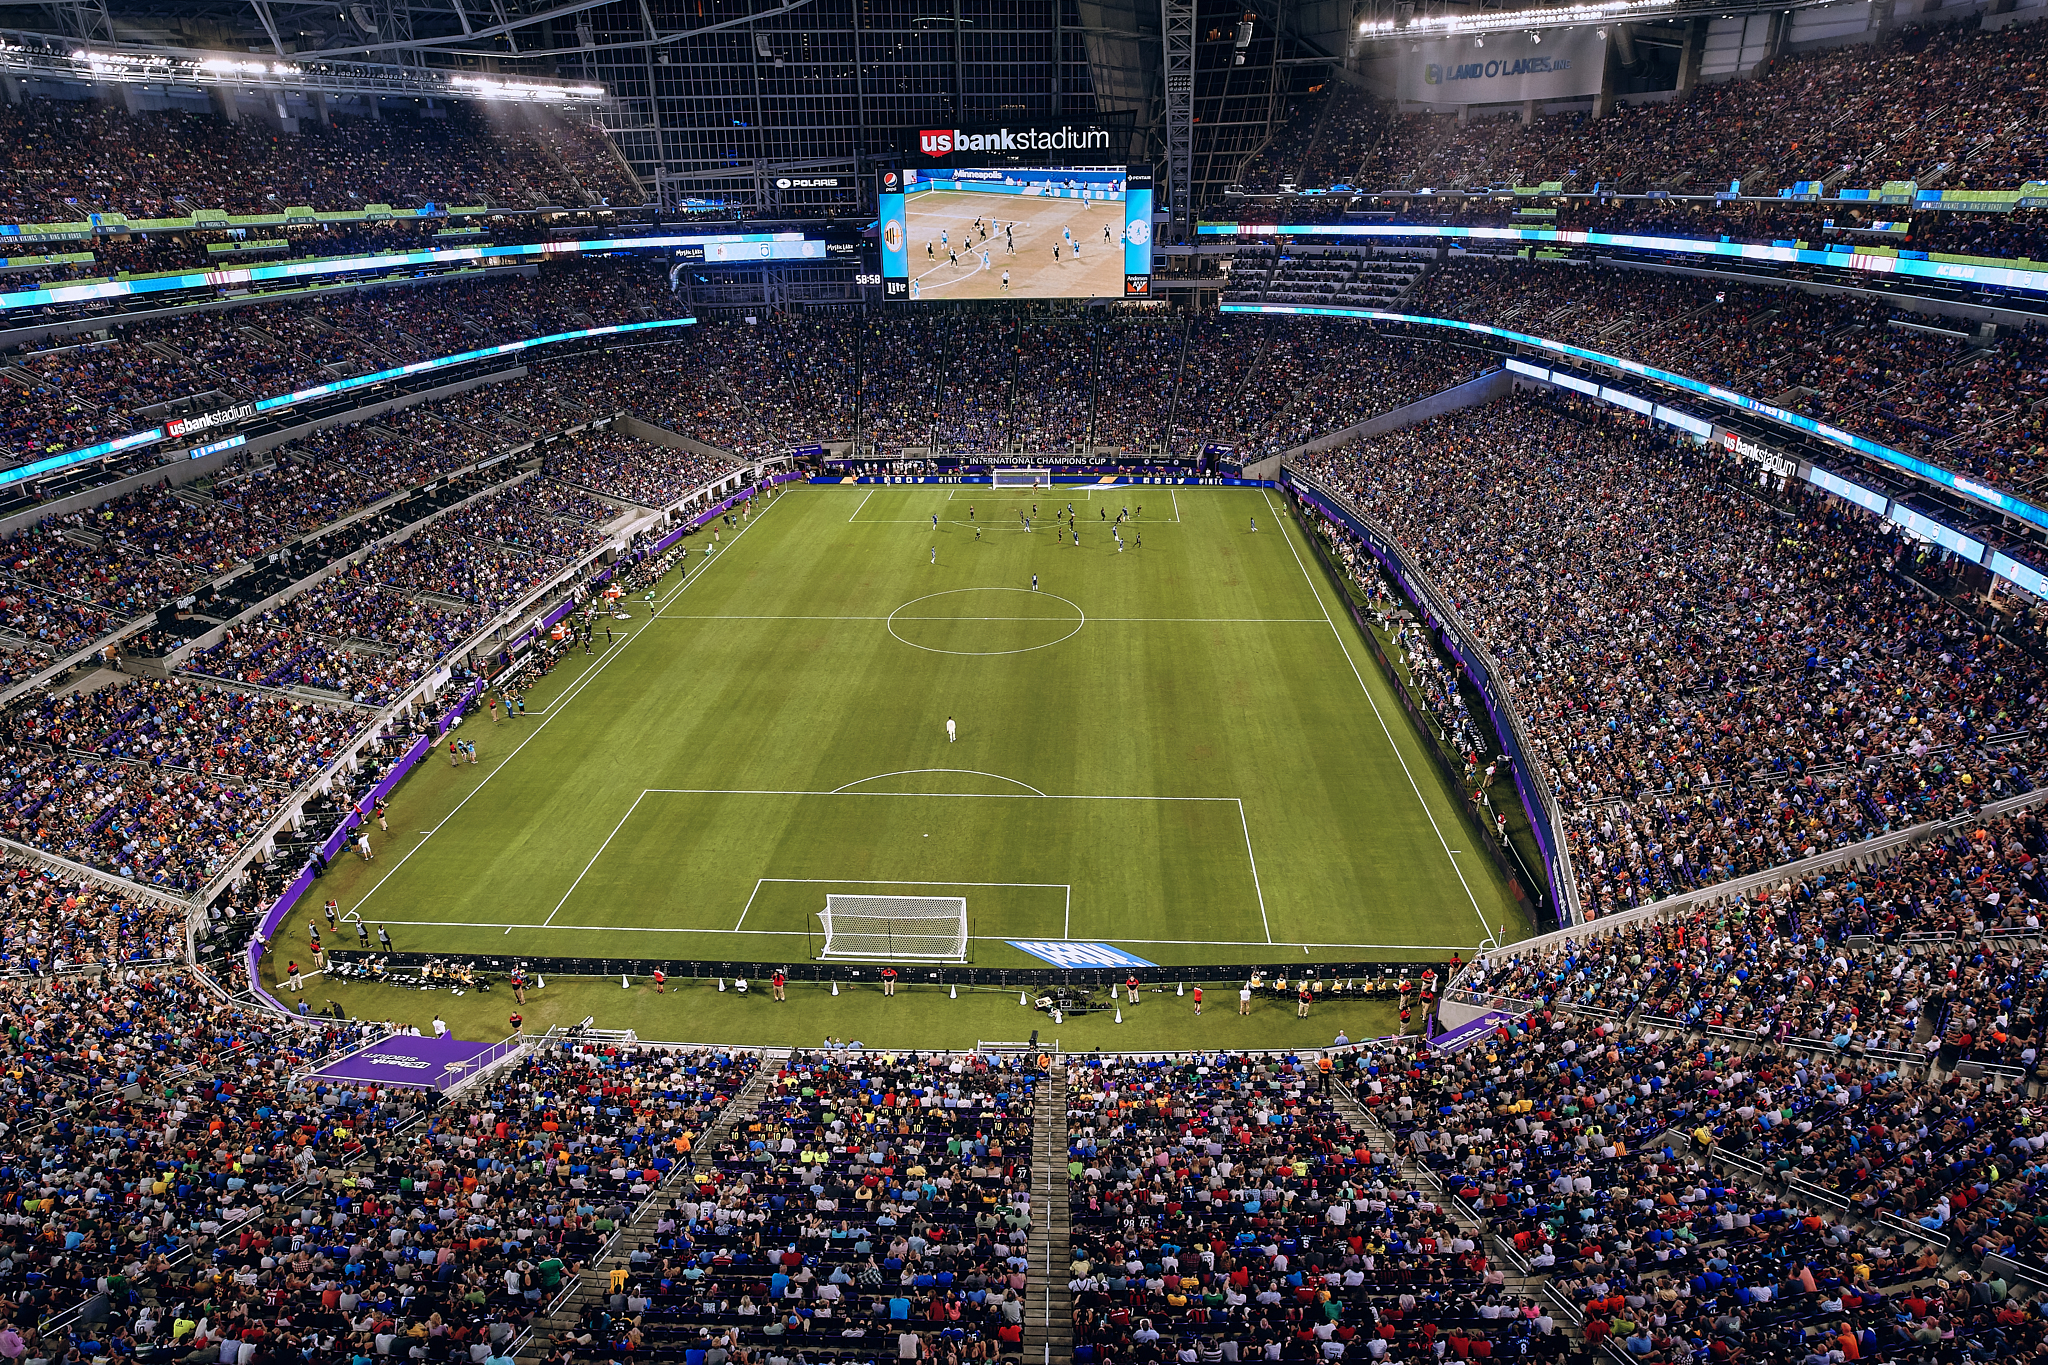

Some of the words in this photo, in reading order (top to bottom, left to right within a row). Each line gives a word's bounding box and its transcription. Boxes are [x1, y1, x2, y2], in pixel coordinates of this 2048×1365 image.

[1446, 62, 1483, 80] LAND
[953, 170, 1003, 179] Minneapolis
[793, 178, 838, 188] POLARIS
[855, 274, 881, 285] 58:58
[887, 282, 906, 295] Lite
[969, 457, 1035, 465] INTERNATIONAL
[1038, 457, 1087, 465] CHAMPIONS
[1088, 457, 1106, 465] CUP
[1023, 1107, 1031, 1116] 10
[913, 1124, 921, 1133] 10
[994, 1122, 1002, 1131] 10
[731, 1131, 739, 1140] 10
[773, 1132, 781, 1140] 10
[1017, 1170, 1026, 1179] 27
[352, 1206, 360, 1214] 10
[703, 1208, 709, 1218] 5
[1123, 1219, 1135, 1228] 98
[1139, 1218, 1150, 1229] 45
[292, 1240, 300, 1250] 10
[1303, 1240, 1309, 1248] 5
[1520, 1343, 1527, 1354] 8
